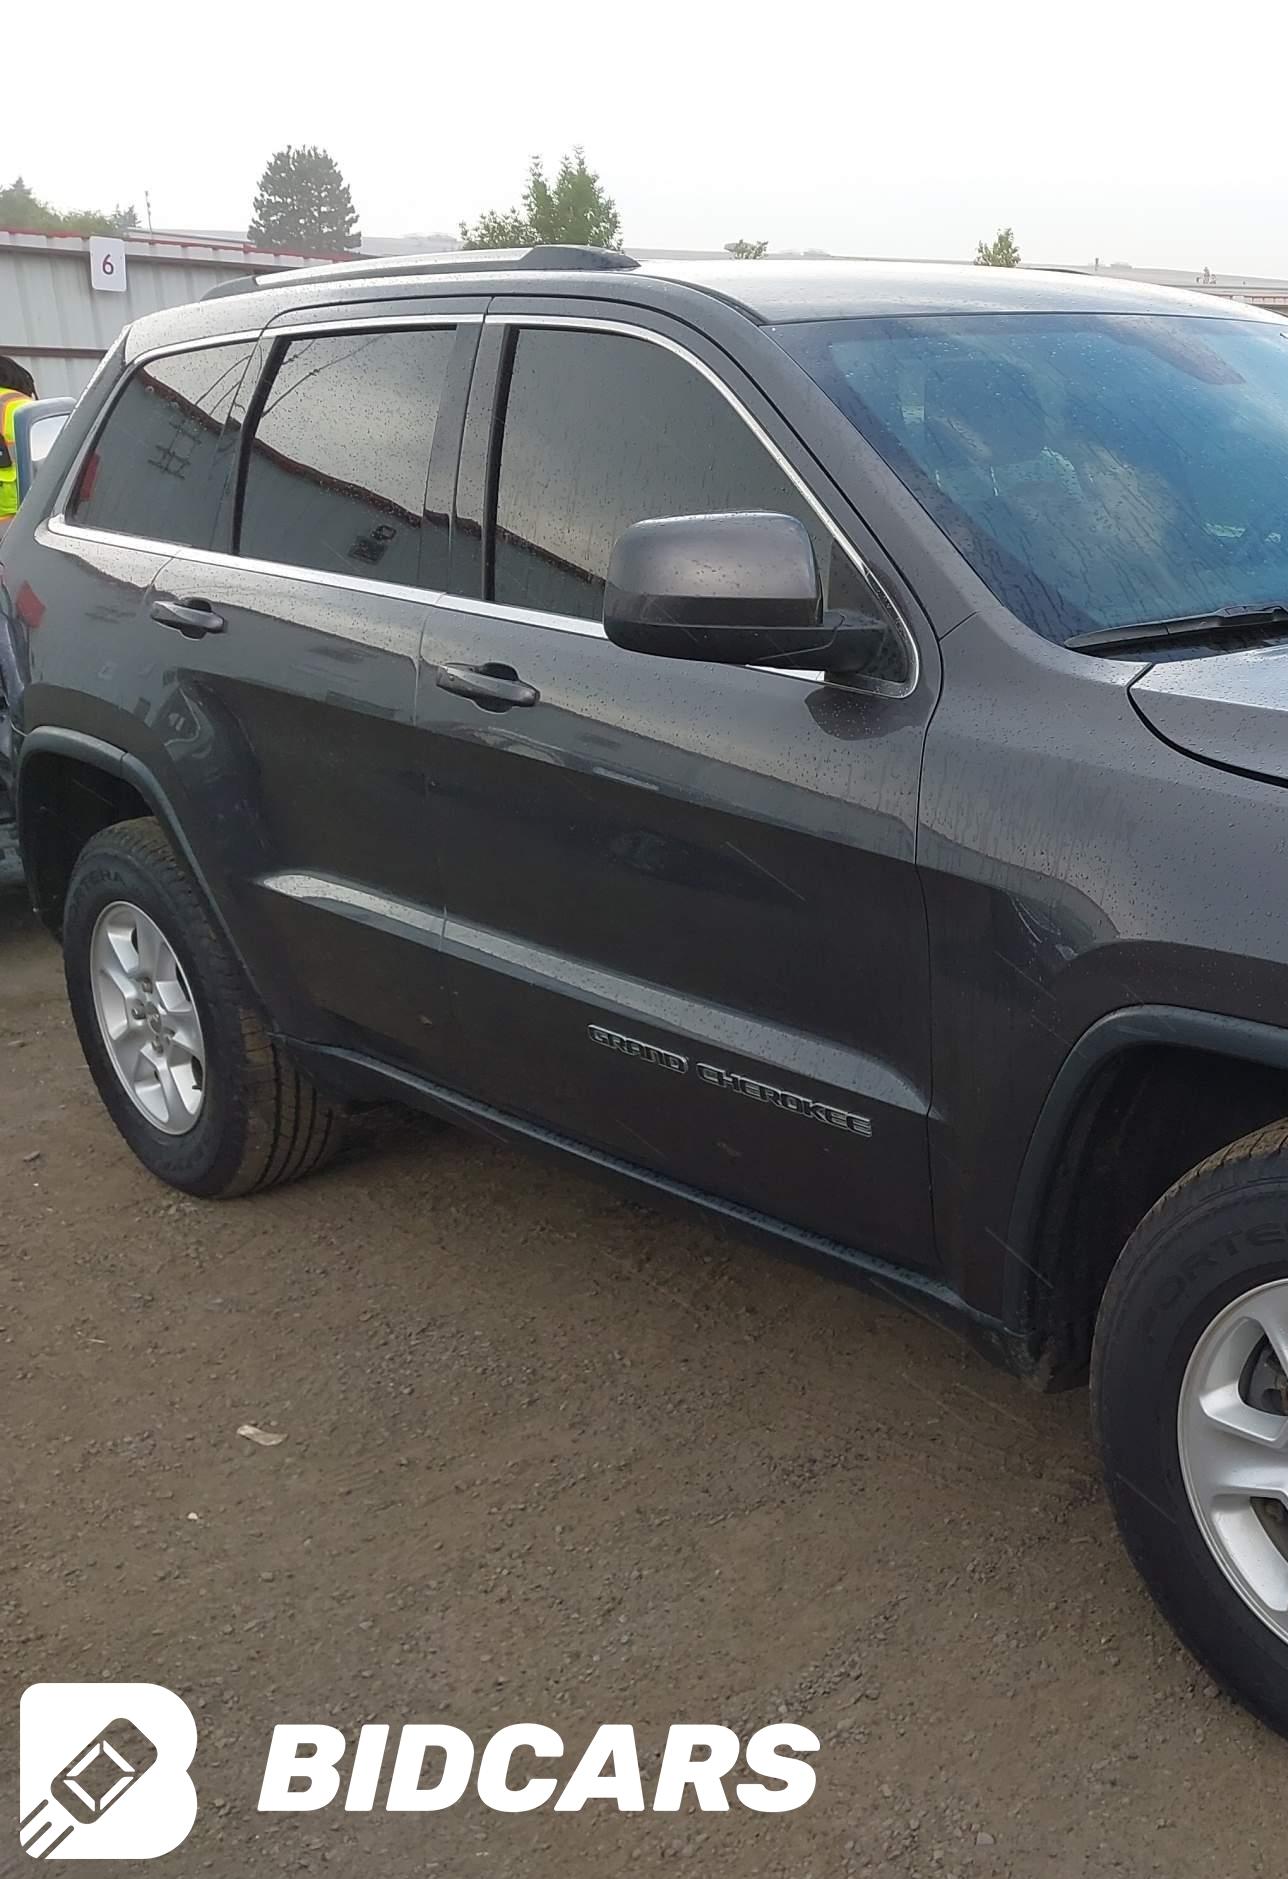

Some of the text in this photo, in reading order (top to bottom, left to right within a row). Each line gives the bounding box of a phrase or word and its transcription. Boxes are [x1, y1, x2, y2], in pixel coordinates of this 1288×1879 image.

[103, 253, 114, 275] 6
[587, 1024, 872, 1138] GRAND CHEROKEE
